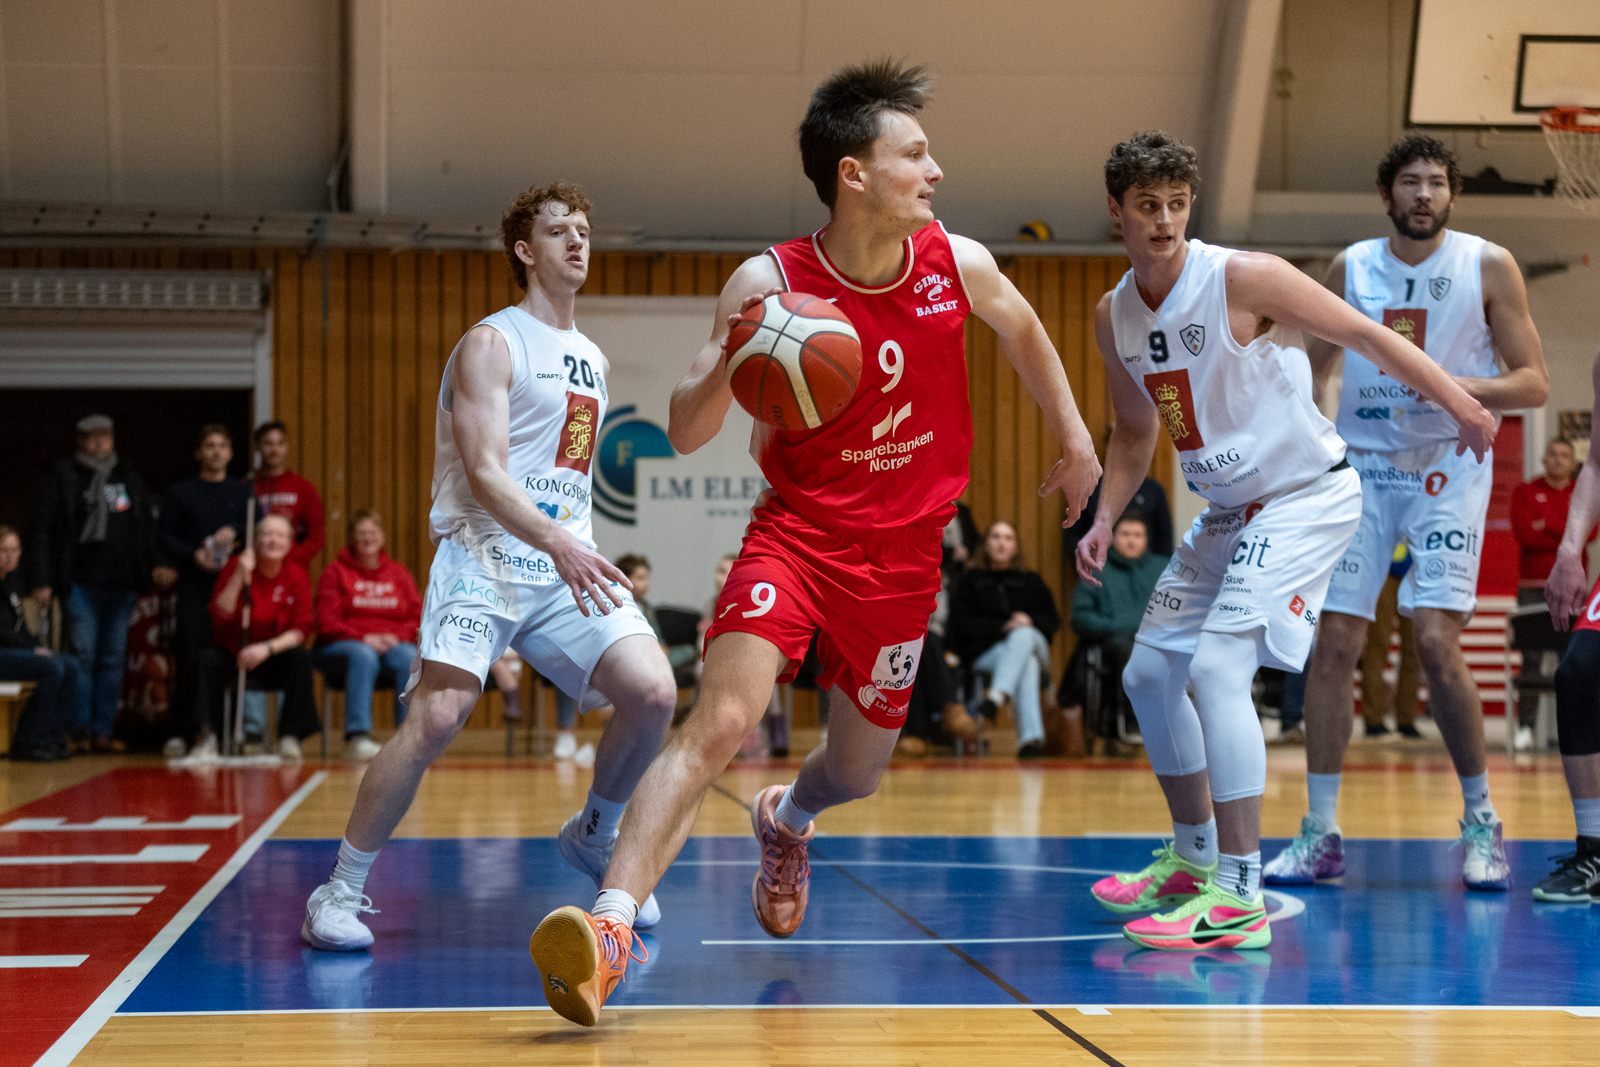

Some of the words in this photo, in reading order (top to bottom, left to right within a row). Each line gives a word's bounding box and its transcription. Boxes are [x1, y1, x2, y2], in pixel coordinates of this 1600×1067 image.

[913, 274, 954, 294] GIMLE
[1406, 278, 1415, 302] 1
[916, 300, 958, 317] BASKET
[1148, 329, 1170, 364] 9
[563, 353, 596, 389] 20
[878, 339, 905, 394] 9
[1359, 386, 1407, 400] KONGS
[841, 430, 934, 464] Sparebanken
[869, 453, 913, 473] Norge
[1181, 447, 1240, 475] GSBERG
[651, 476, 693, 500] LM
[1359, 466, 1423, 484] pareBank
[1231, 534, 1272, 569] cit
[1426, 527, 1478, 557] ecit
[491, 545, 560, 576] SpareBa
[1168, 558, 1201, 584] ari
[1225, 575, 1245, 585] Skue
[449, 578, 512, 614] Akari
[741, 581, 777, 619] 9
[1150, 589, 1182, 612] acta
[1219, 604, 1244, 613] CRAFT
[439, 613, 494, 643] exacta
